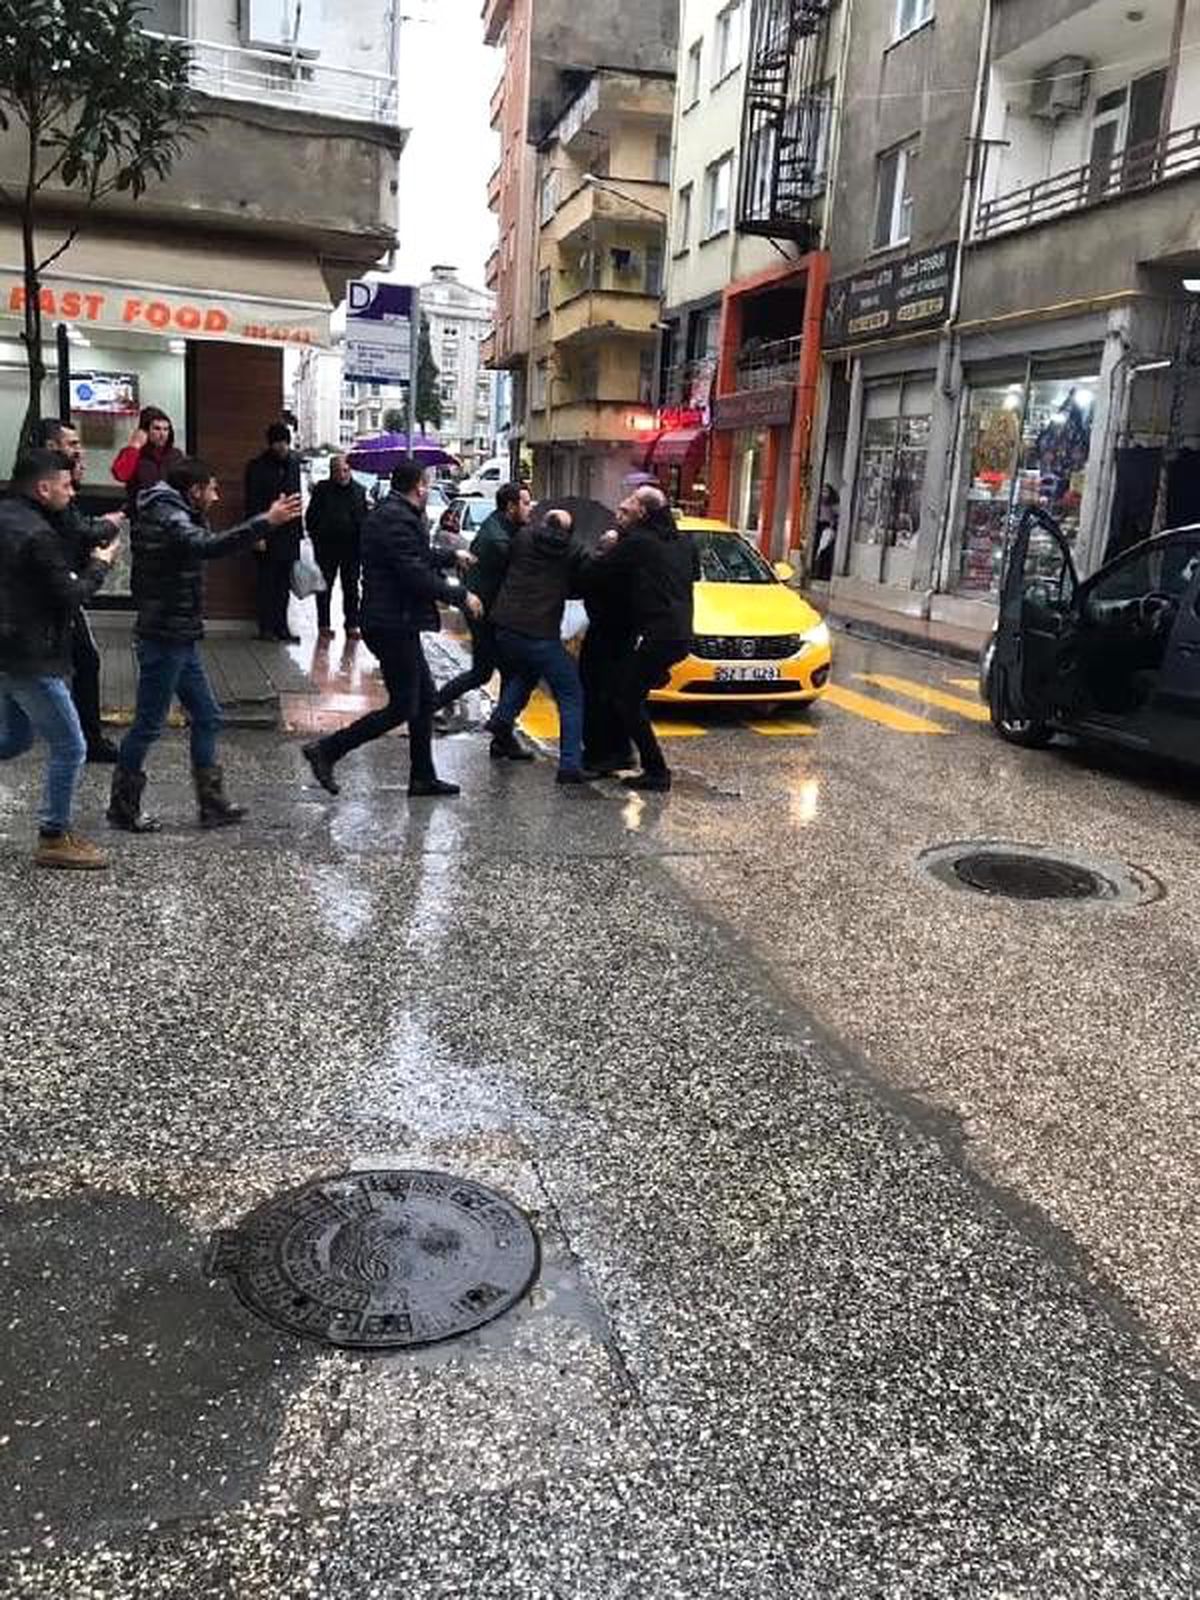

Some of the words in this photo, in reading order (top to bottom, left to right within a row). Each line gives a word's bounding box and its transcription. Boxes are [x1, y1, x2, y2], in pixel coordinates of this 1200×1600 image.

[9, 287, 105, 321] FAST
[122, 298, 229, 332] FOOD
[349, 282, 371, 310] D
